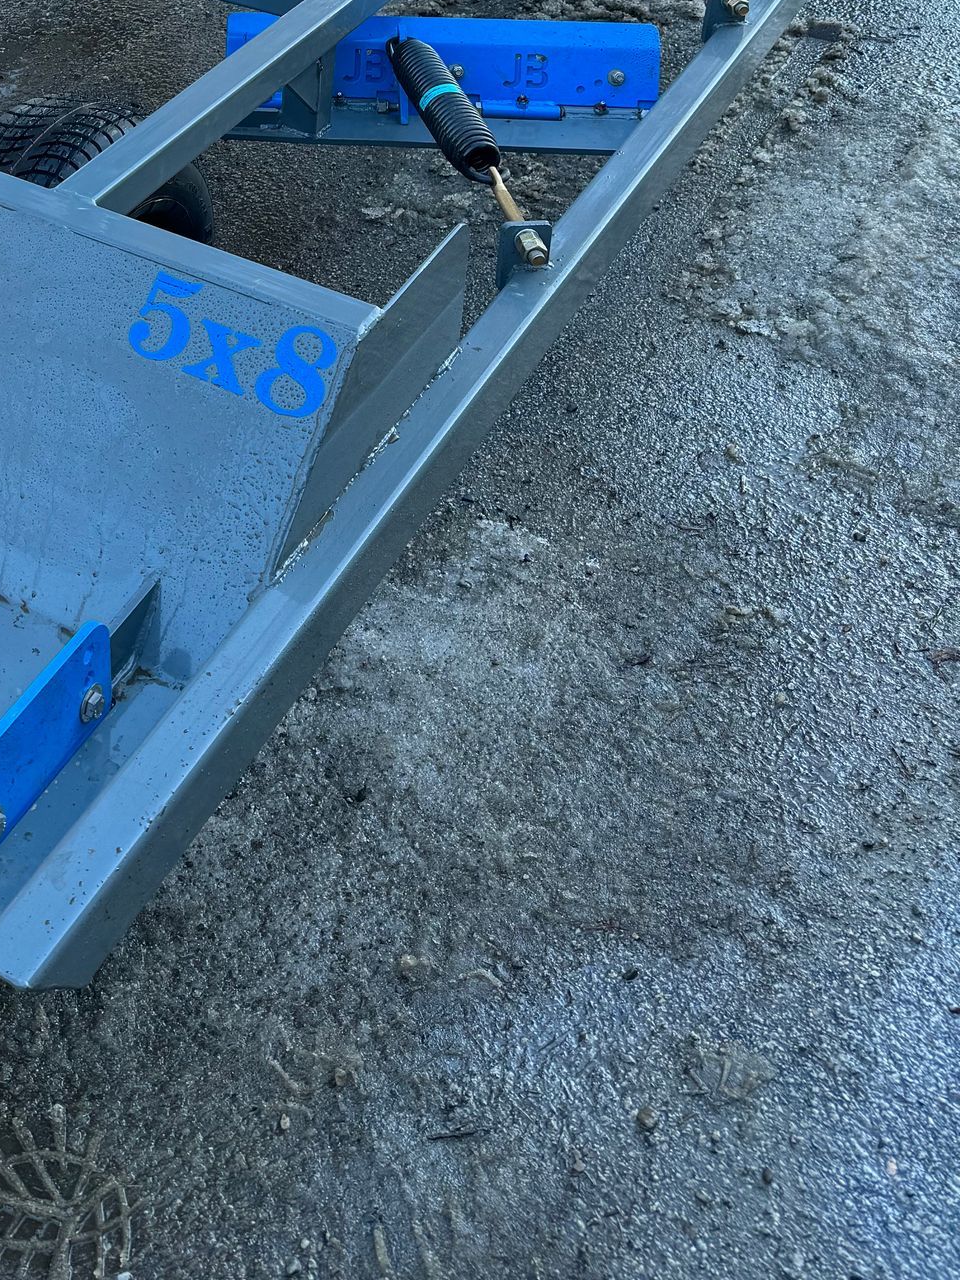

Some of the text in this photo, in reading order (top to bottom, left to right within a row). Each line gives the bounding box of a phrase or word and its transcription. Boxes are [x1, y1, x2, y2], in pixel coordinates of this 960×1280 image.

[342, 48, 388, 82] JB
[502, 52, 548, 88] JB
[128, 271, 338, 418] 5x8
